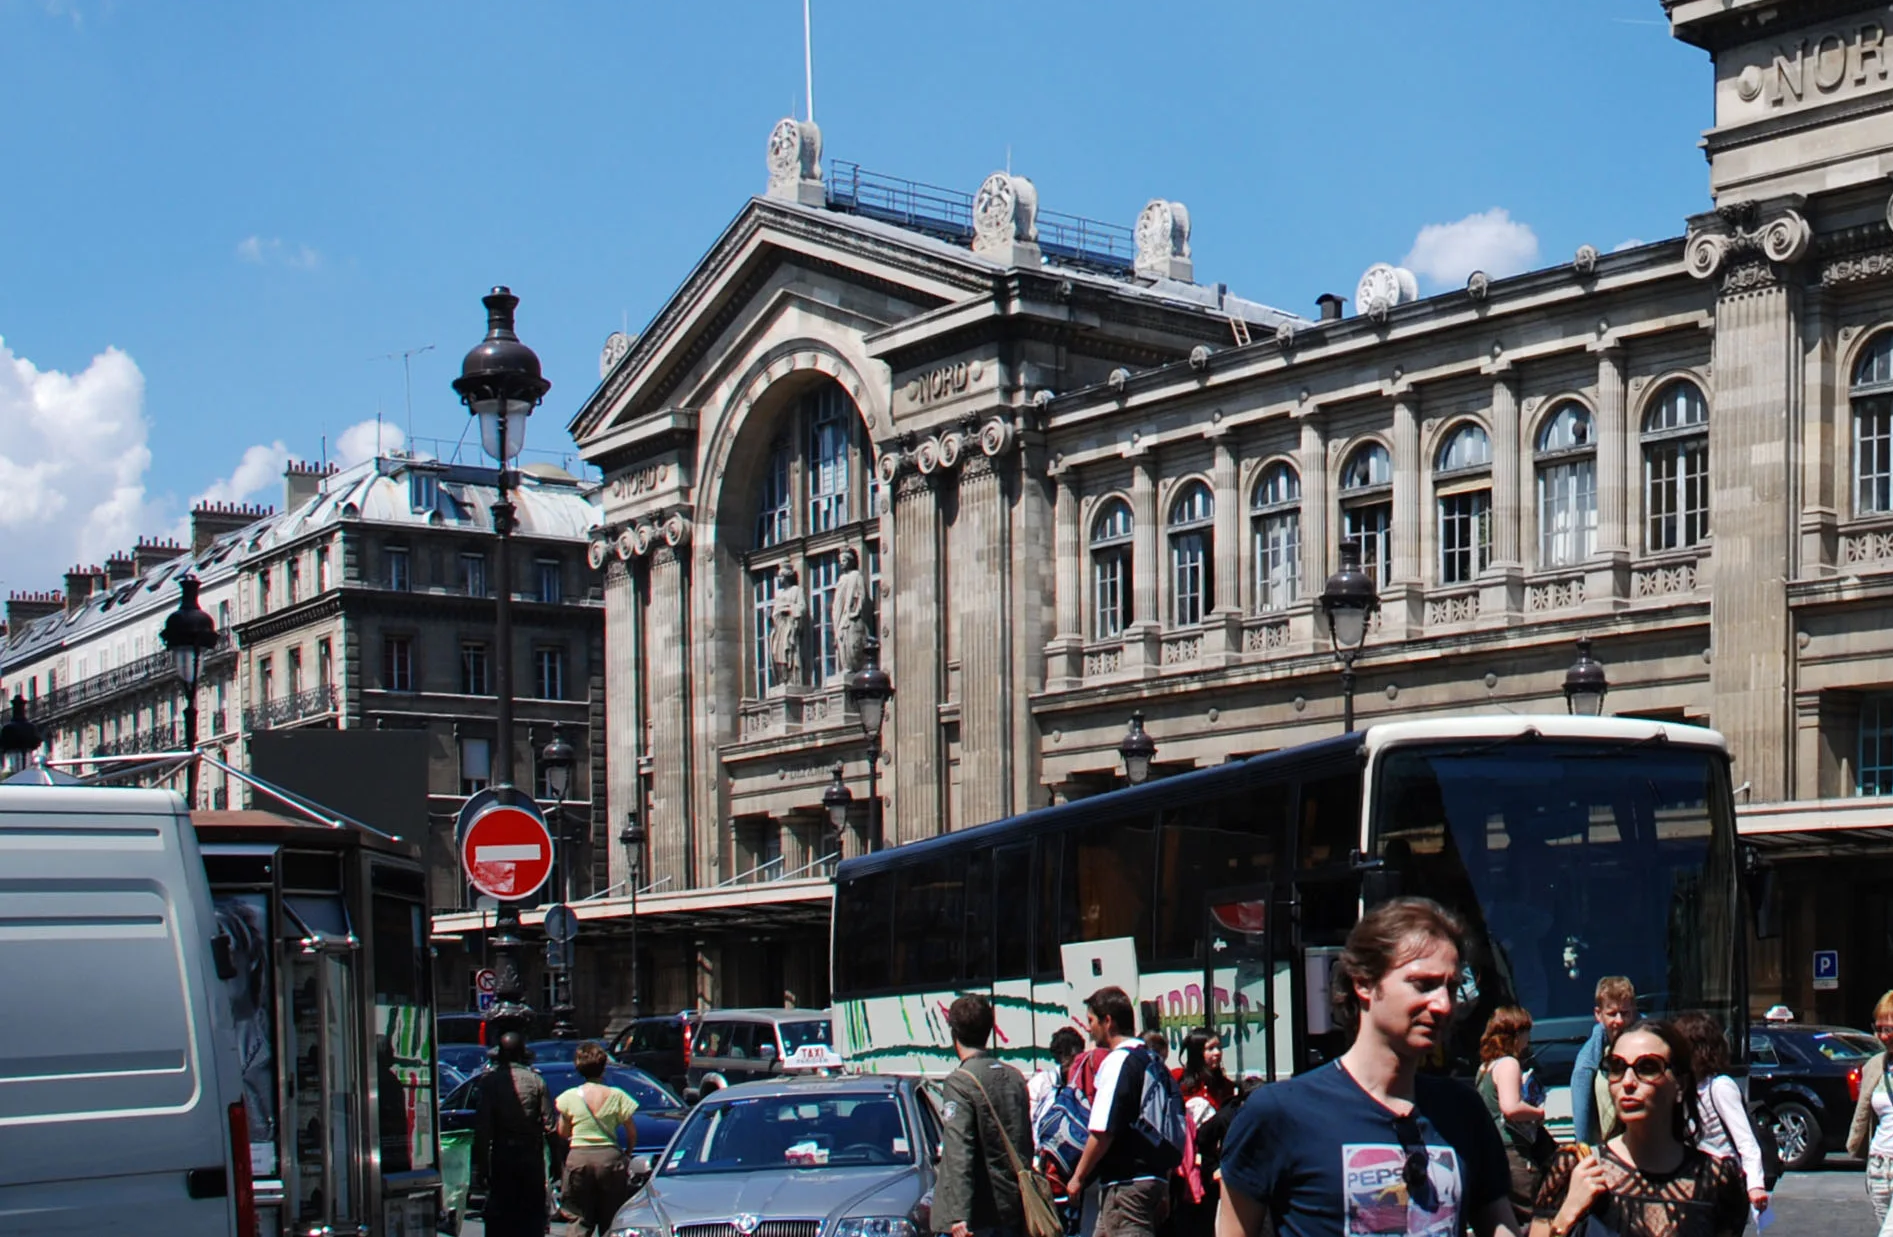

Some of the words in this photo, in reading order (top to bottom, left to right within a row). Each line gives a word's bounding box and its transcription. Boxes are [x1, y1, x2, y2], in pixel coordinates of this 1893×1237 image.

[918, 362, 967, 404] NORD
[618, 467, 657, 500] NORD
[1820, 956, 1831, 974] P
[800, 1047, 824, 1058] TAXI
